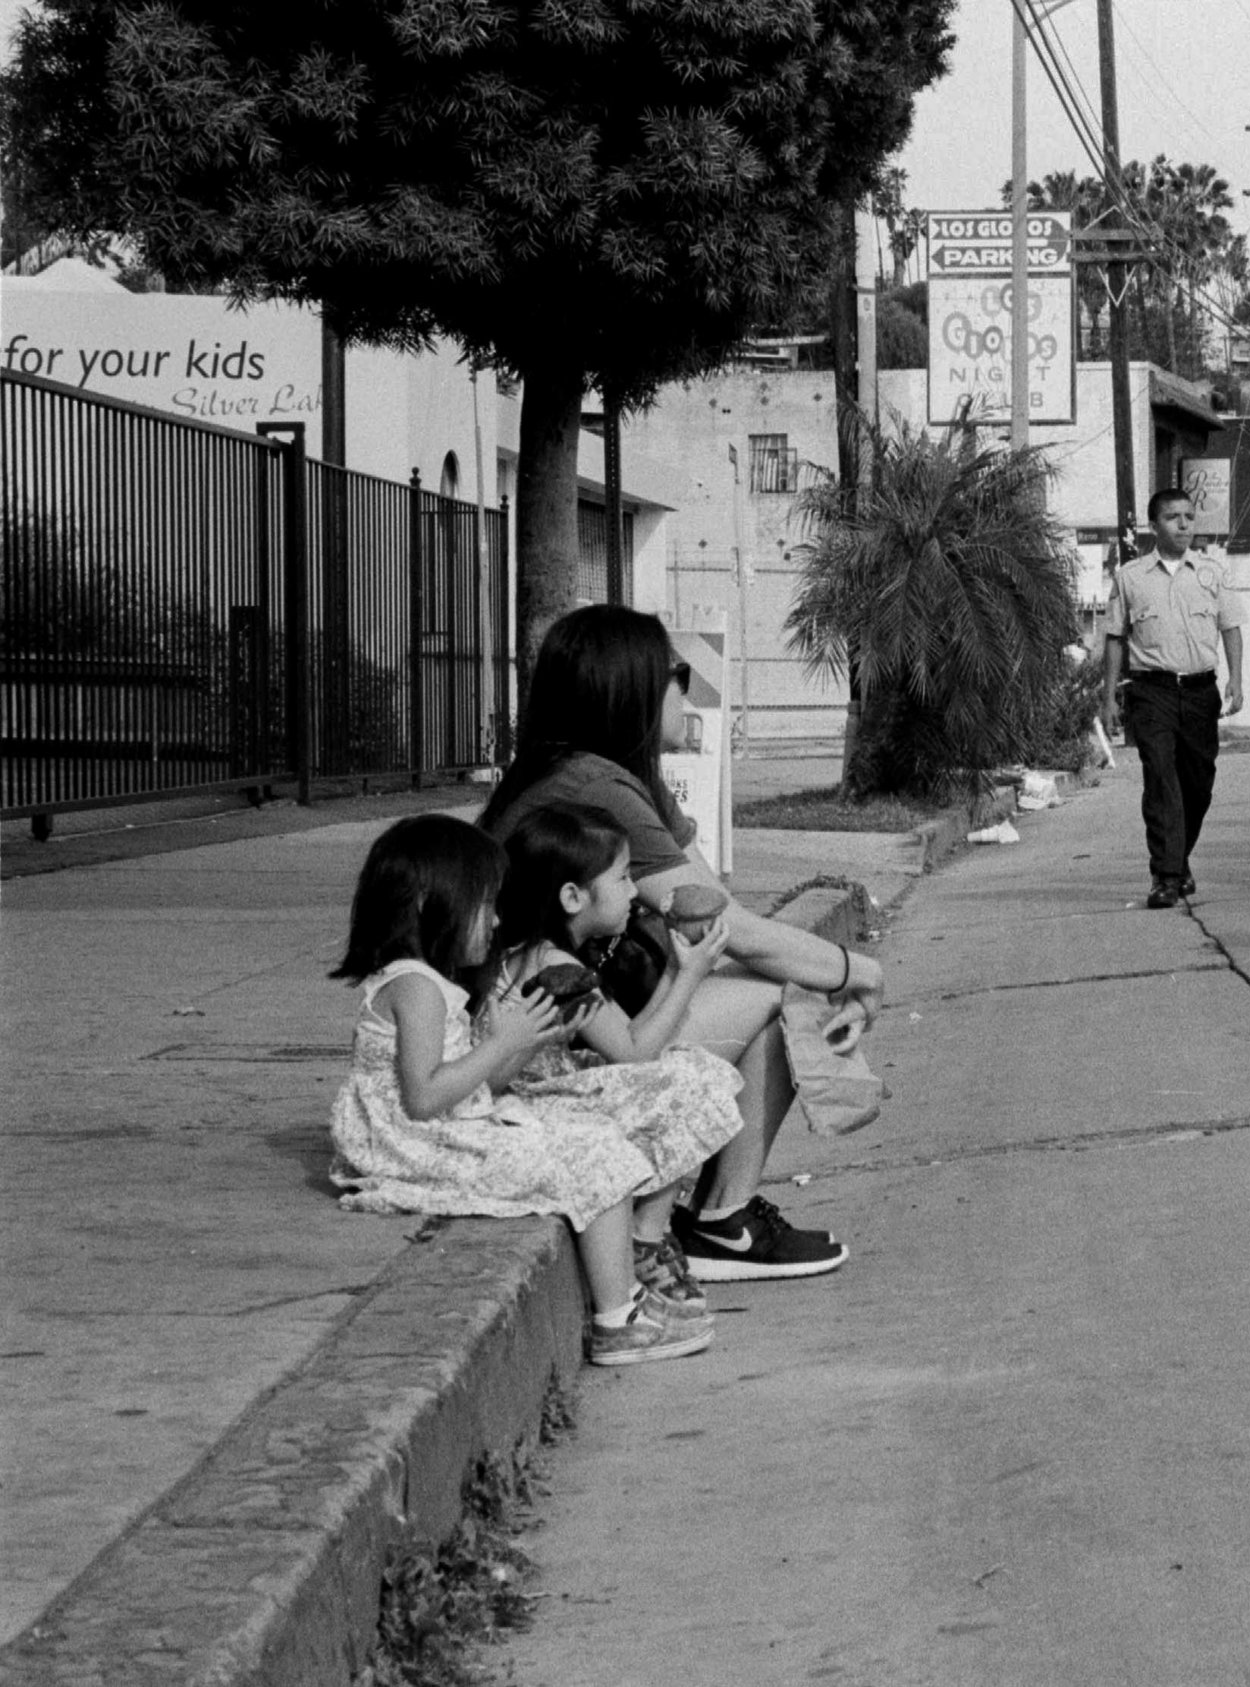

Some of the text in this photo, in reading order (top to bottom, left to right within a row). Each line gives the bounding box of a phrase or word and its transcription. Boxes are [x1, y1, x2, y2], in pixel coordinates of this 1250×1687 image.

[942, 220, 1053, 237] LOS GLOOS
[944, 249, 1058, 265] PARKNG
[4, 334, 265, 388] for your kids
[950, 367, 1051, 381] NIGT
[171, 386, 259, 417] Silver
[269, 384, 322, 416] Lak
